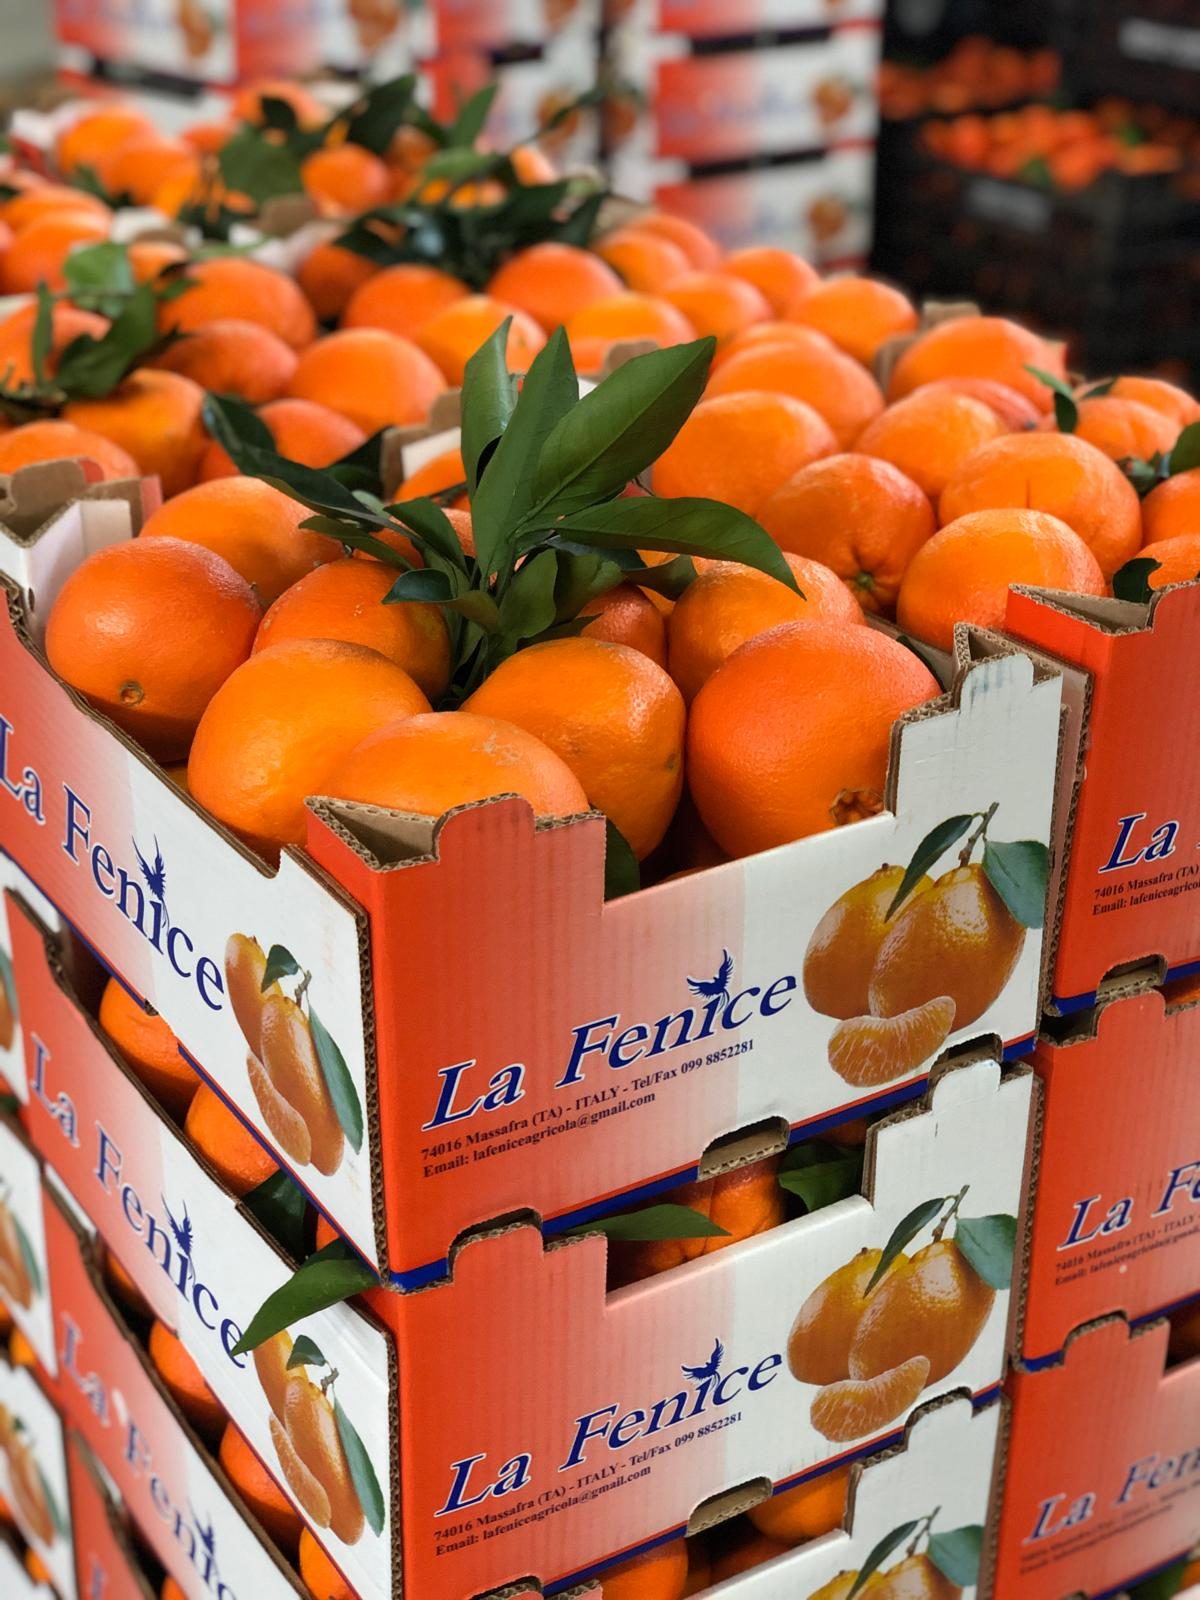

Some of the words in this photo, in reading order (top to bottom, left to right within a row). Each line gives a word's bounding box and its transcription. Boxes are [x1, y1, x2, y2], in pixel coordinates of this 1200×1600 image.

[0, 715, 45, 825] La
[62, 783, 226, 1013] Fenice
[1094, 882, 1124, 899] 74016
[1127, 872, 1173, 891] Massafra
[1175, 864, 1199, 880] (TA)
[1098, 812, 1179, 873] La
[1092, 898, 1127, 916] Email:
[31, 1032, 80, 1148] La
[421, 1059, 526, 1132] La
[555, 970, 798, 1088] Fenice
[420, 1139, 462, 1161] 74016
[466, 1118, 528, 1147] Massafra
[532, 1106, 563, 1127] (TA)
[575, 1085, 619, 1110] ITALY
[631, 1068, 677, 1091] Tel/Fax
[681, 1058, 702, 1075] 099
[706, 1039, 754, 1066] 8852281
[423, 1155, 469, 1178] Email:
[473, 1092, 656, 1161] lafeniceagricola@gmail.com
[1056, 1193, 1134, 1252] La
[433, 1521, 473, 1541] 74016
[476, 1499, 535, 1527] Massafra
[538, 1486, 566, 1506] (TA)
[577, 1463, 618, 1488] ITALY
[629, 1444, 672, 1466] Tel/Fax
[675, 1431, 695, 1448] 099
[697, 1411, 742, 1440] 8852281
[434, 1452, 531, 1519] La
[558, 1352, 783, 1473] Fenice
[435, 1534, 480, 1557] Email:
[483, 1465, 652, 1541] lafeniceagricola@gmail.com
[1022, 1492, 1096, 1546] La
